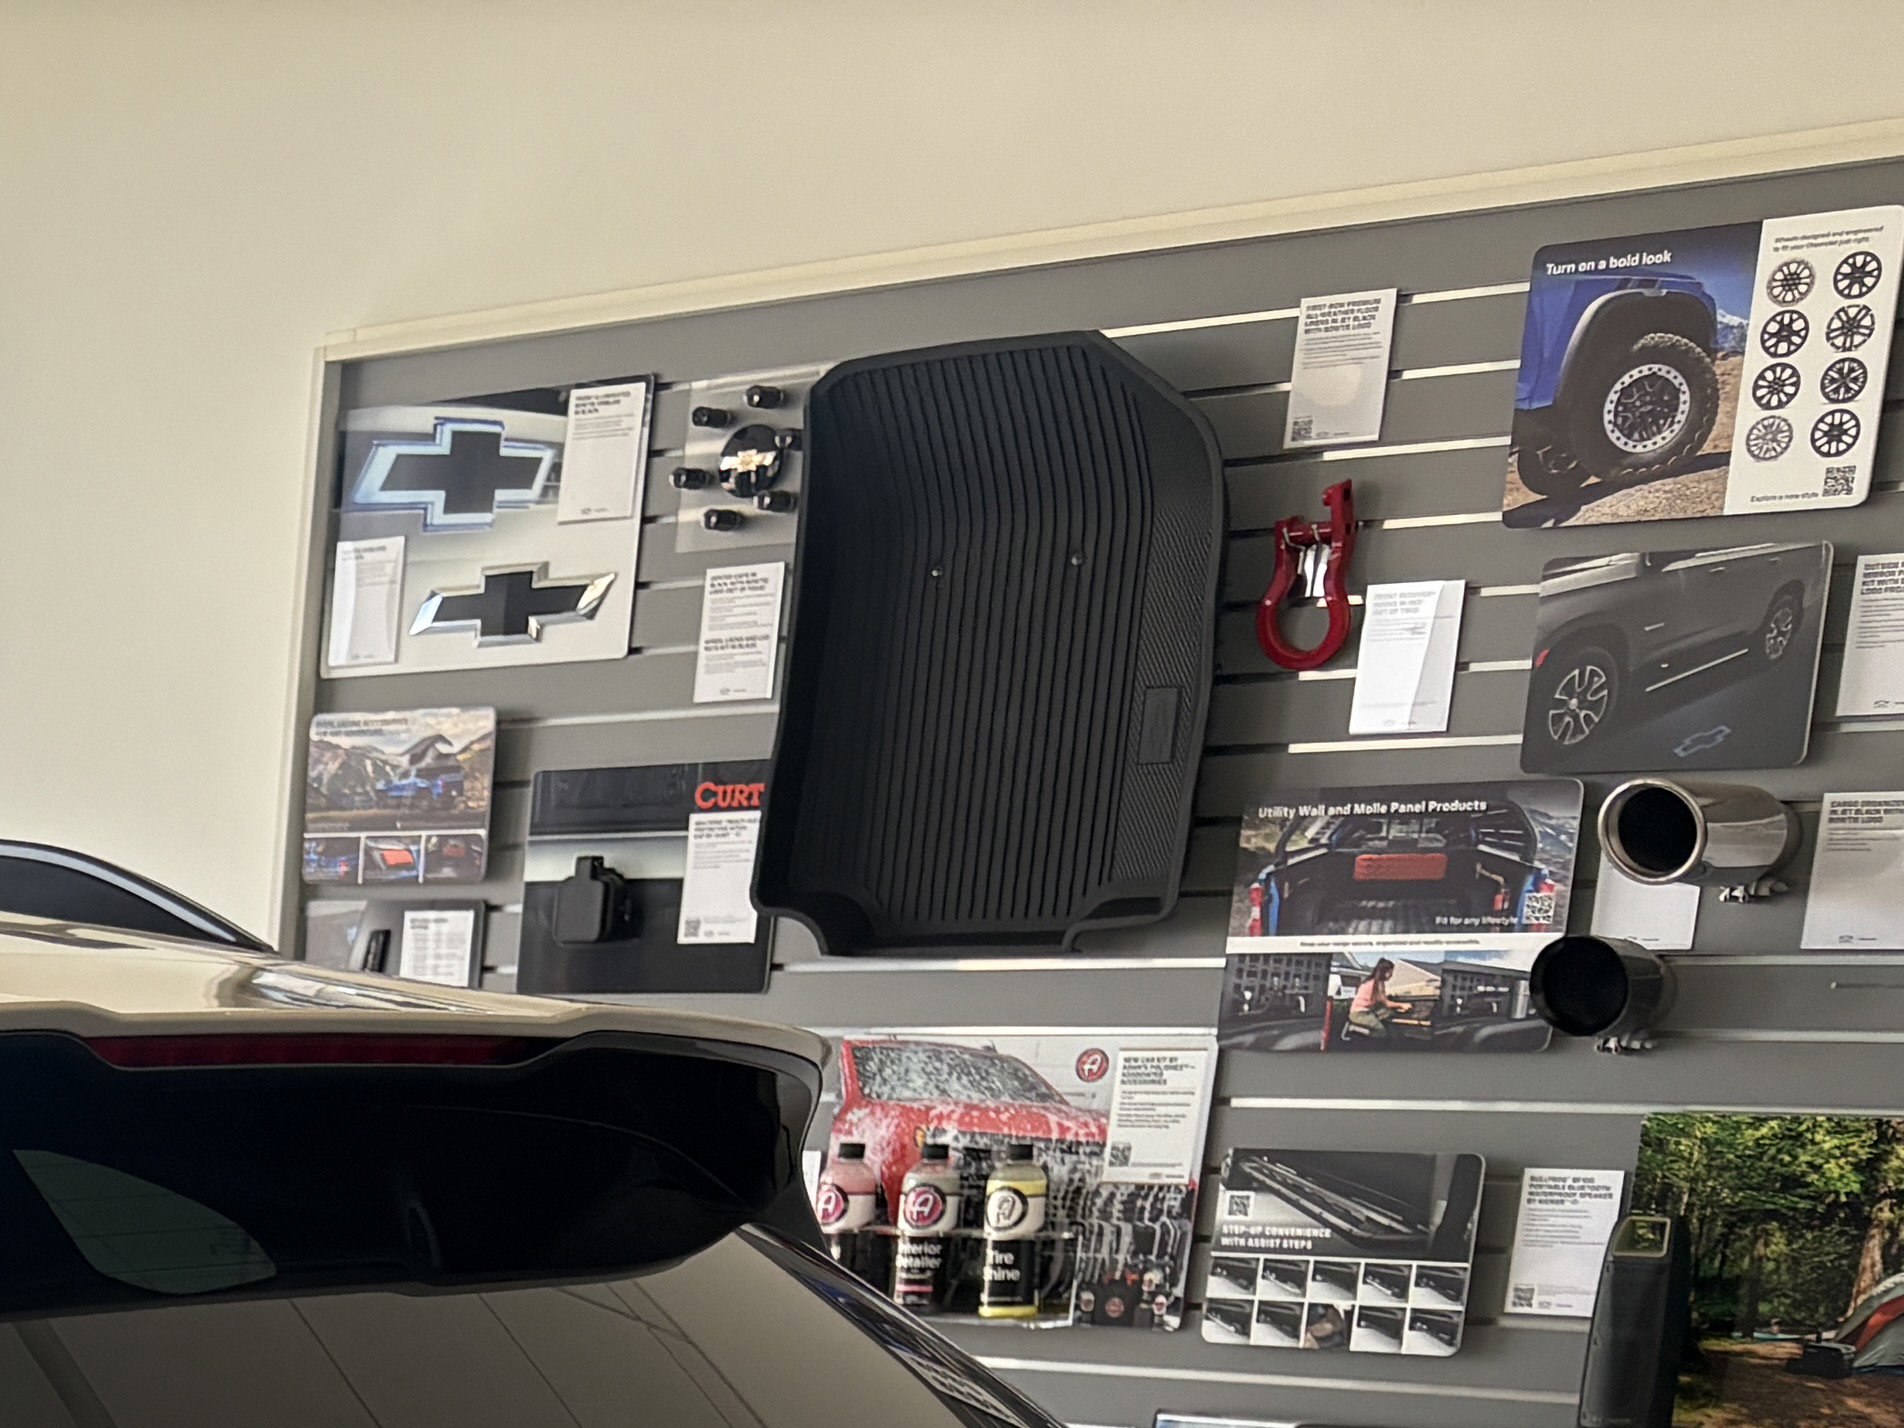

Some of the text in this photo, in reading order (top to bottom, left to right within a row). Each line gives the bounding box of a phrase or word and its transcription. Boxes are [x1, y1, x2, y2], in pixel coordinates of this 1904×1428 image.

[1546, 250, 1672, 275] Turn on a bold look
[694, 781, 766, 810] CURT
[1258, 799, 1488, 819] Utility Wall and Molle Panel Products
[1222, 1224, 1332, 1238] STEP-UP CONVENIENCE
[1221, 1236, 1312, 1250] WITH ASSIST STEPS
